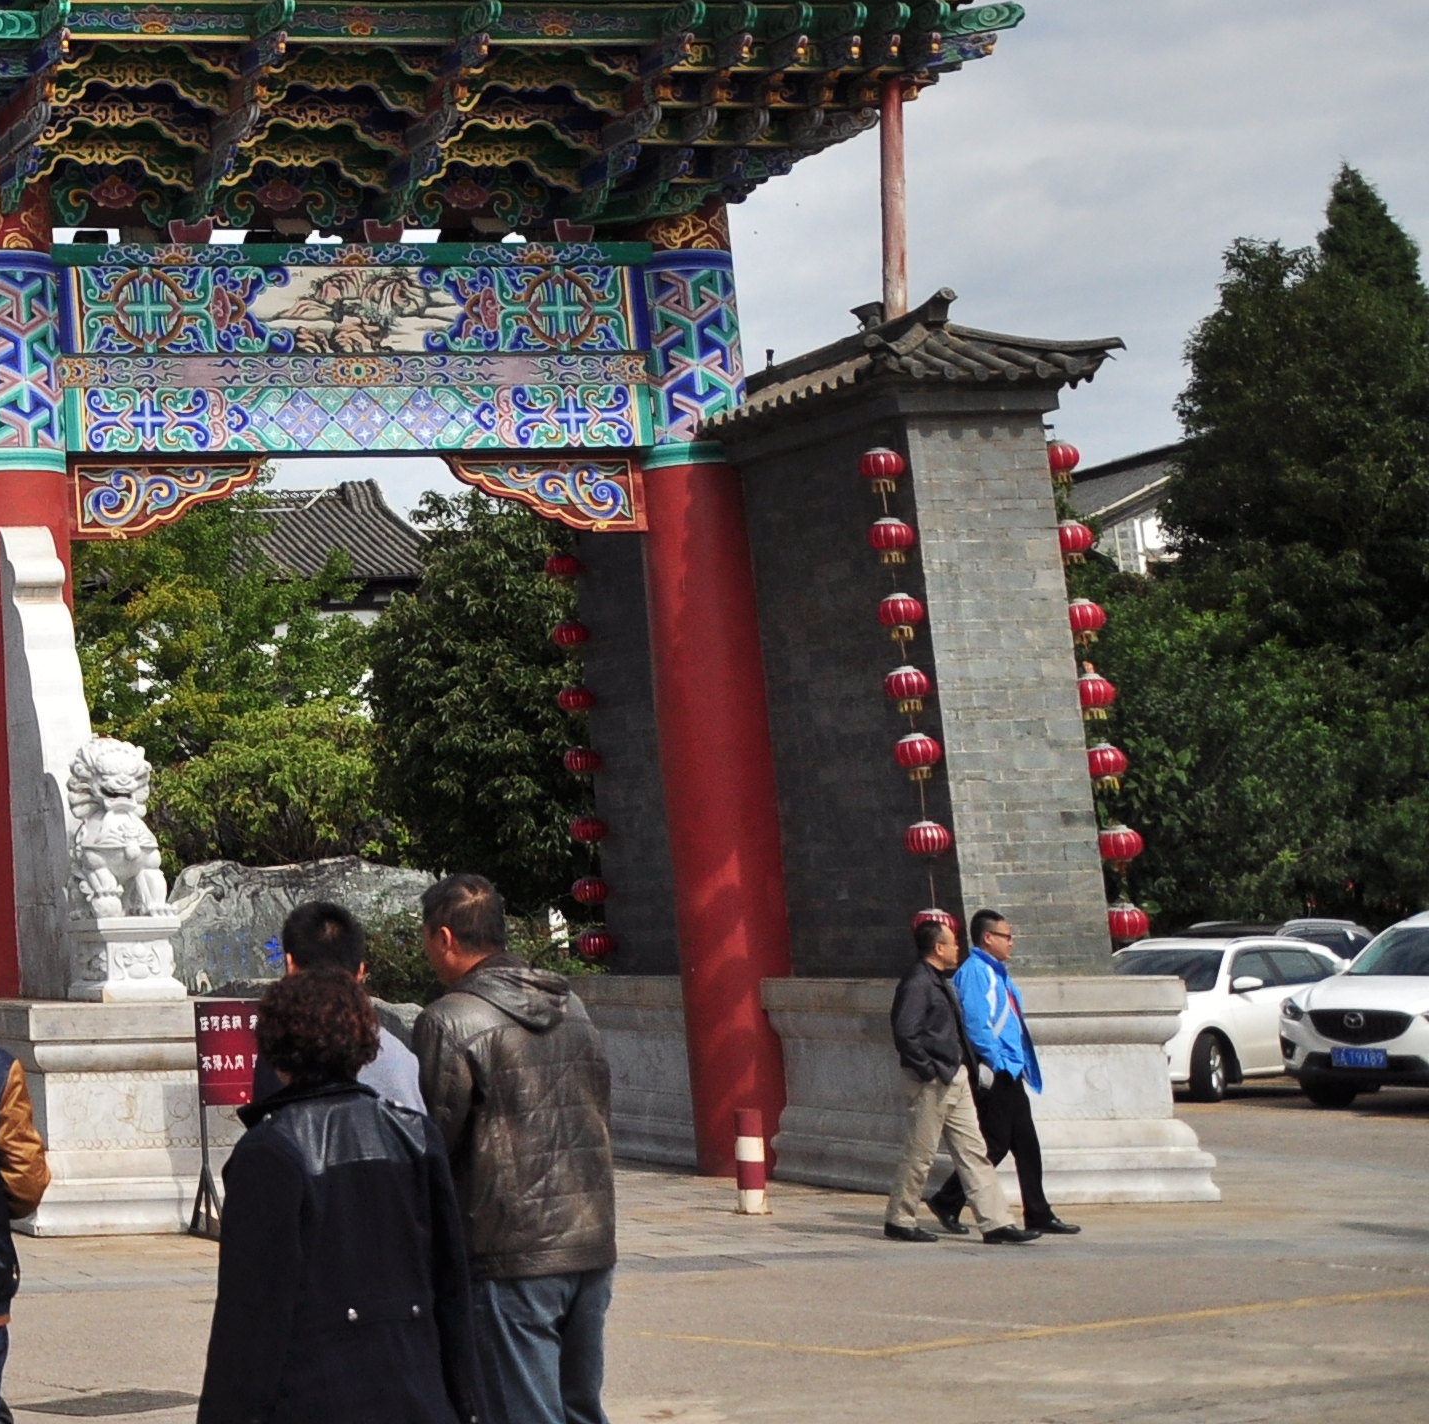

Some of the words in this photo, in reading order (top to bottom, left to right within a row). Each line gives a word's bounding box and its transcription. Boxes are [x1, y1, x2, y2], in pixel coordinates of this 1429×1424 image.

[199, 1015, 243, 1032] 任何车辆
[201, 1054, 246, 1071] 不得入内
